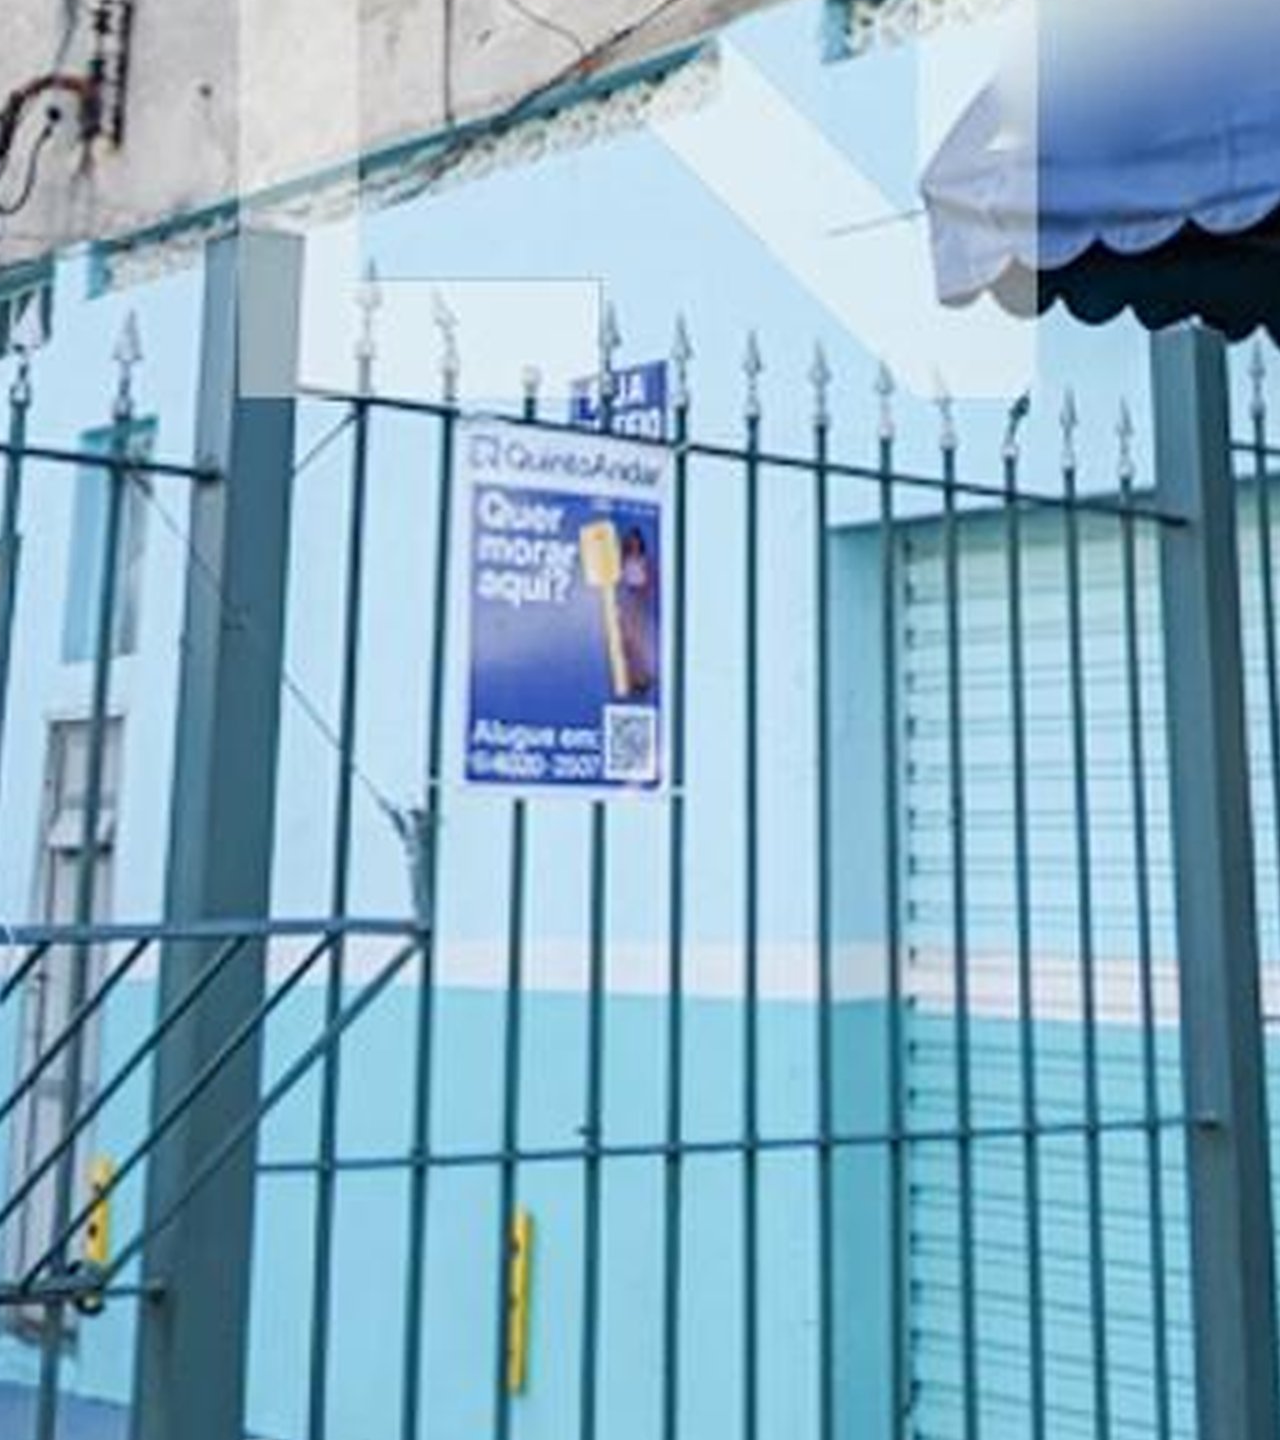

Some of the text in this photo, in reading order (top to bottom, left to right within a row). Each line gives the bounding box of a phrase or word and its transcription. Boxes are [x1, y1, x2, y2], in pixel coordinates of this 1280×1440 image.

[477, 490, 564, 535] Quer
[477, 533, 578, 568] morar
[476, 566, 571, 609] aqui?
